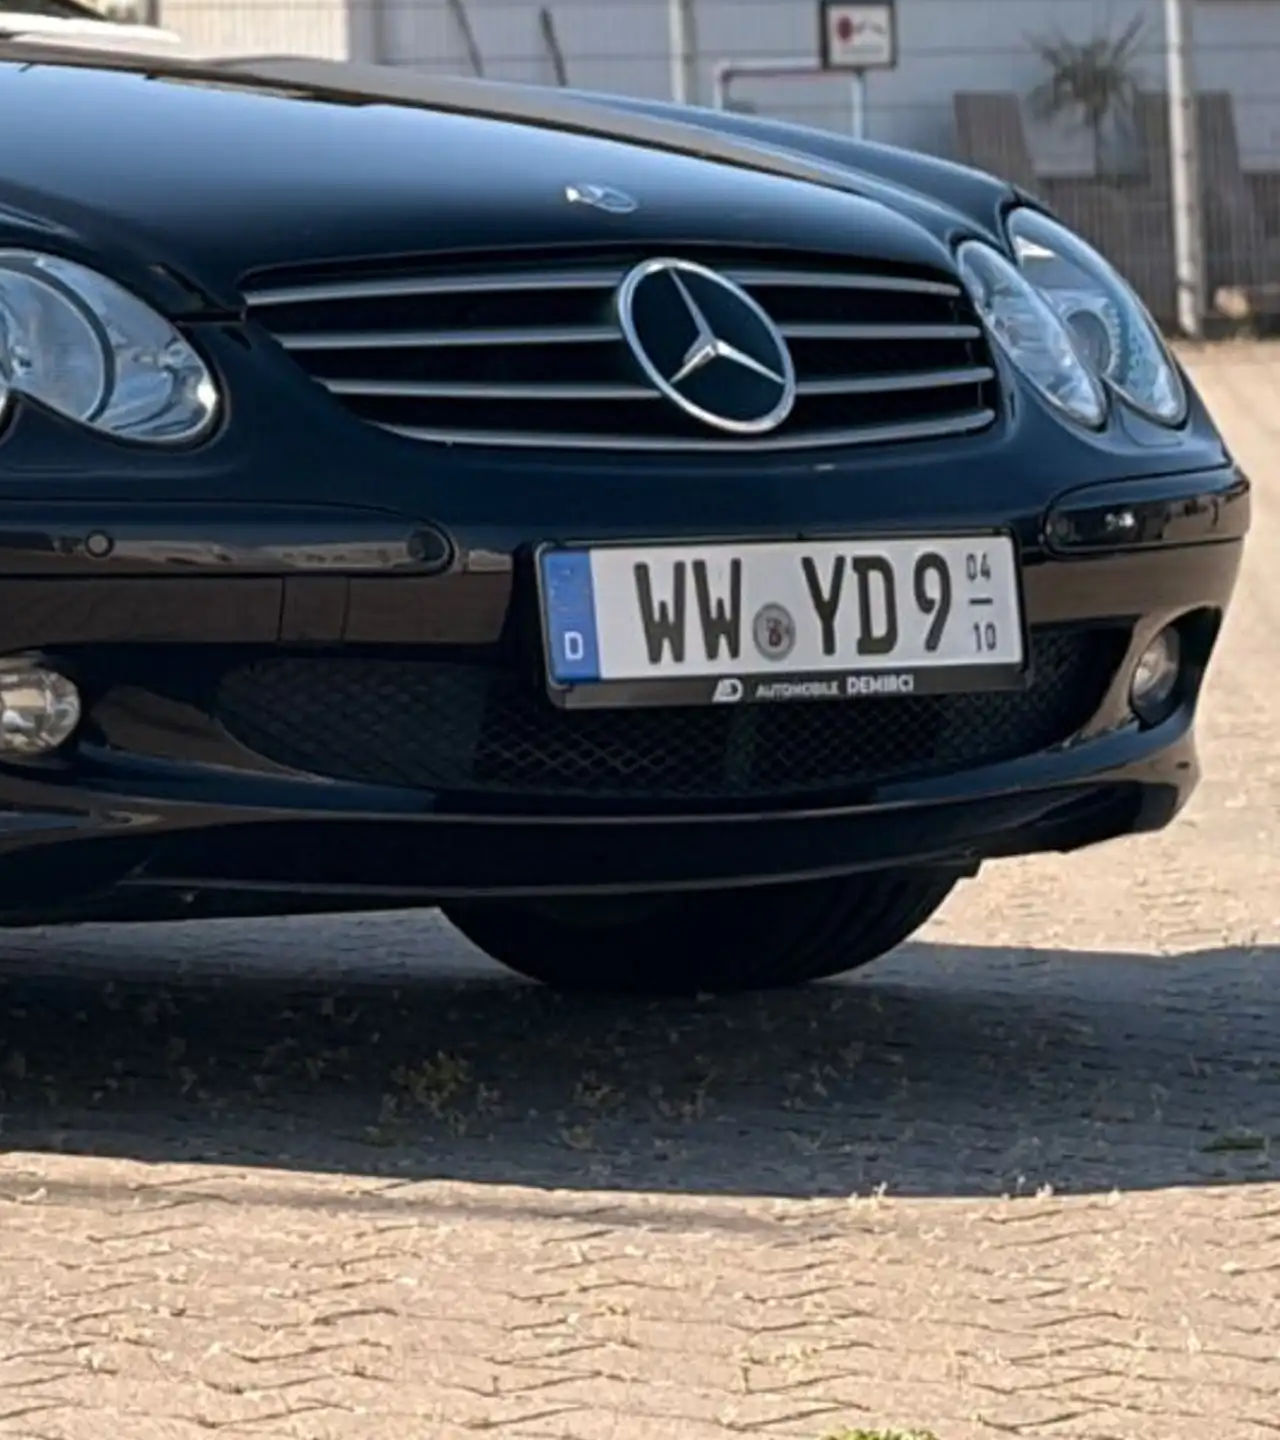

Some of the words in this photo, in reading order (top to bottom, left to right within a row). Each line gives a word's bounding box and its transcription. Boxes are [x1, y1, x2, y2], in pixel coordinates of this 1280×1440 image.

[965, 552, 992, 581] 04
[634, 558, 742, 665] WW
[563, 631, 585, 661] D
[972, 622, 997, 652] 10
[755, 681, 839, 699] AUTOMOBILE
[845, 673, 915, 696] DEMIRCI
